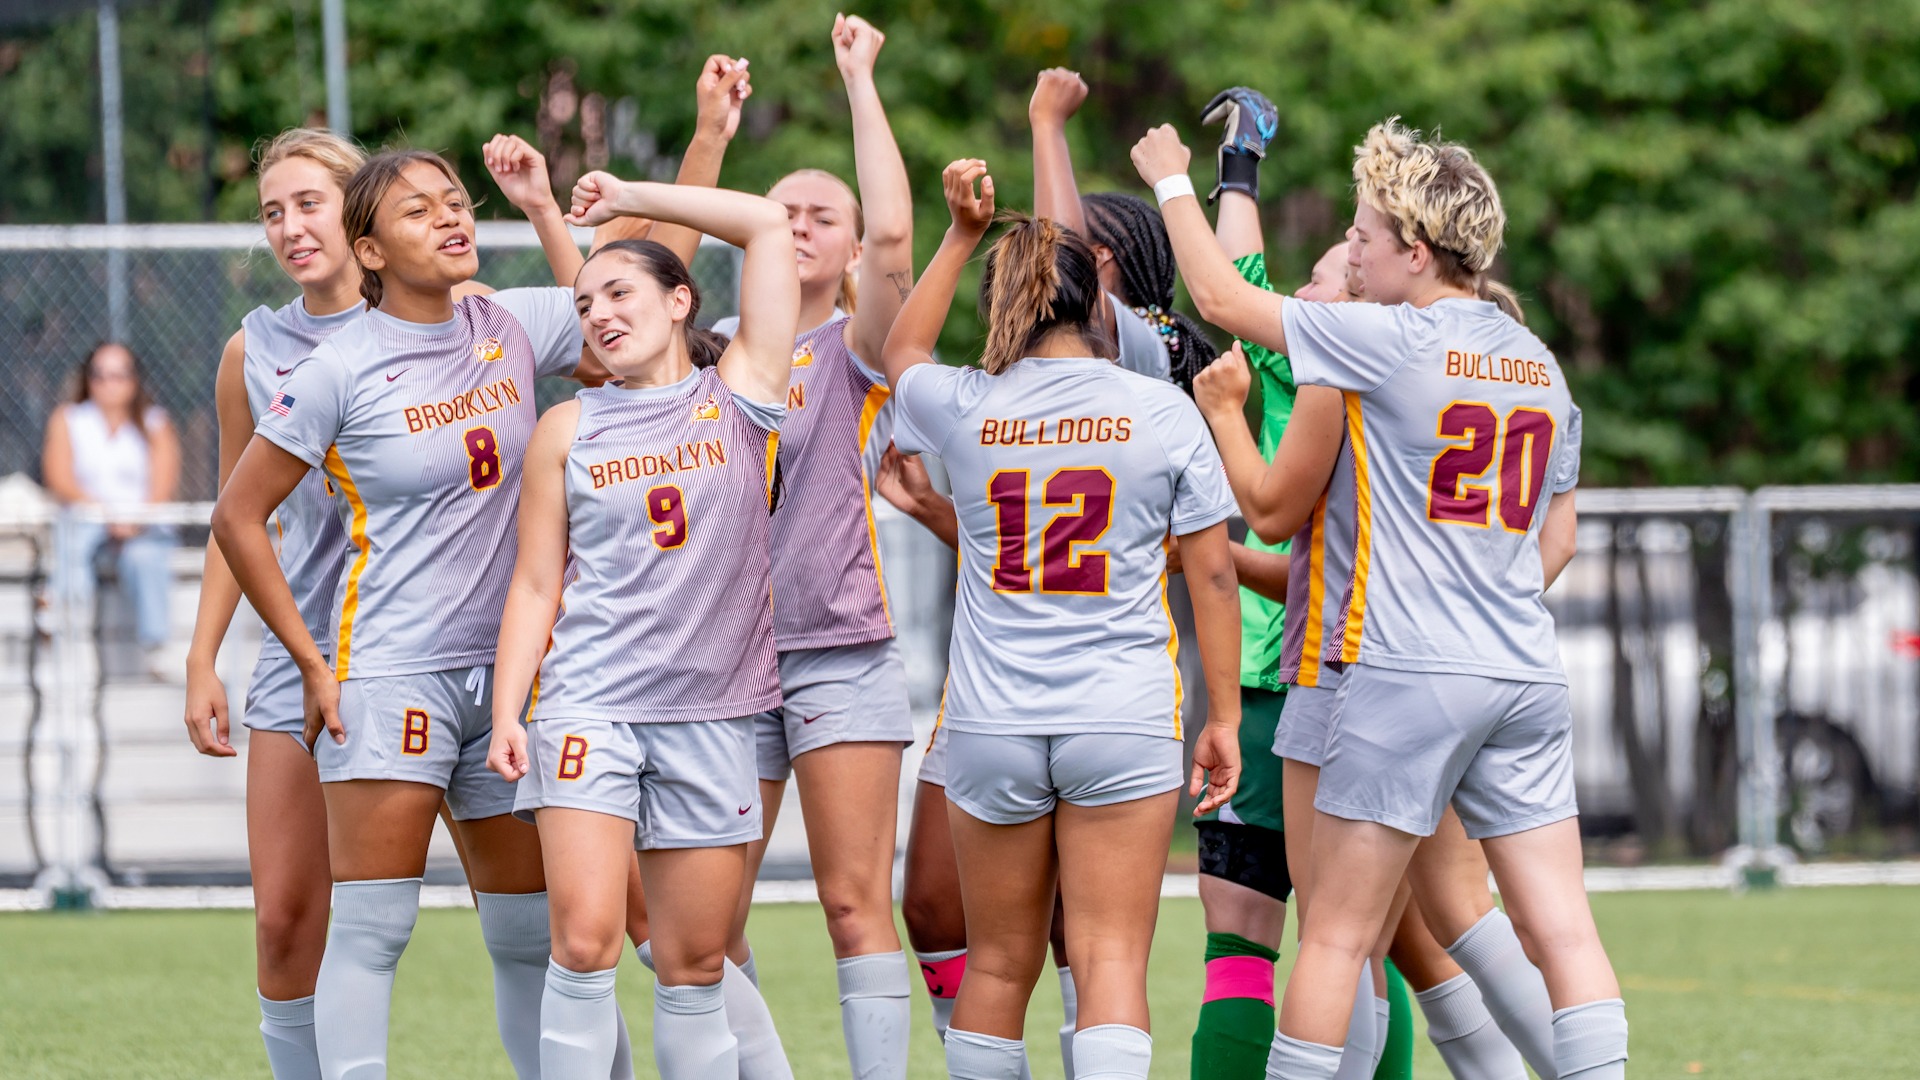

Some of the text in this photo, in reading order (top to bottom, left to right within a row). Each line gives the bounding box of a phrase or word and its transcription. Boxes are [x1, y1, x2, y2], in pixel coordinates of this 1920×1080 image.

[1445, 350, 1551, 387] BULLDOGS
[403, 377, 521, 434] BROOKLYN
[979, 417, 1132, 446] BULLDOGS
[462, 425, 503, 492] 8
[589, 438, 726, 490] BROOKLYN
[1426, 399, 1557, 535] 20
[645, 484, 689, 551] 9
[986, 466, 1117, 596] 12
[402, 707, 430, 756] B
[557, 734, 590, 780] B
